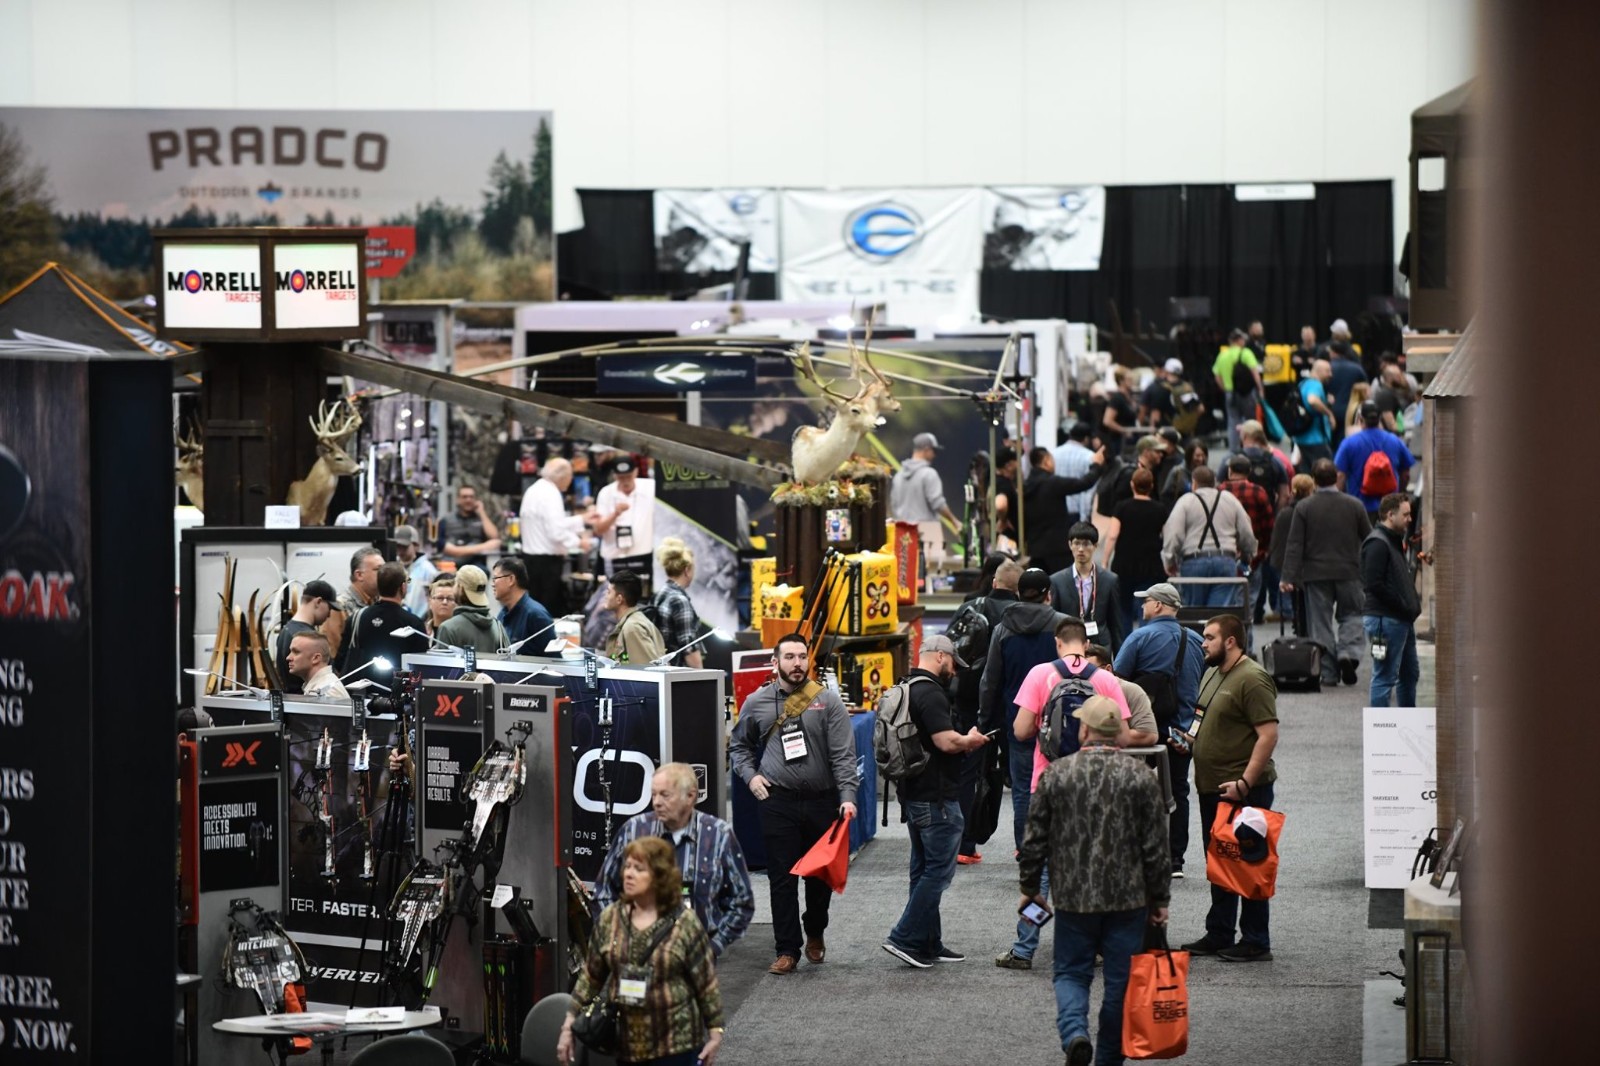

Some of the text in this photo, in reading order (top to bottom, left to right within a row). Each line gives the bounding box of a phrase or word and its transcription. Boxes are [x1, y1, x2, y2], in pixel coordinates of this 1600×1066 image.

[147, 126, 389, 172] PRADCO
[179, 187, 361, 199] OUTDOOR BRANDS
[168, 270, 261, 294] MORRELL
[275, 269, 356, 294] MORRELL
[805, 279, 956, 296] ELITE
[225, 292, 261, 303] TARGETS
[325, 290, 356, 301] TARGETS
[0, 569, 74, 621] OAK
[0, 766, 35, 800] RS
[427, 787, 453, 802] RESULTS.
[203, 802, 257, 820] ACCESSIBILITY
[203, 819, 230, 835] MEETS
[203, 833, 248, 851] INNOVATION.
[574, 846, 592, 856] 90%
[13, 1017, 78, 1054] NOW.
